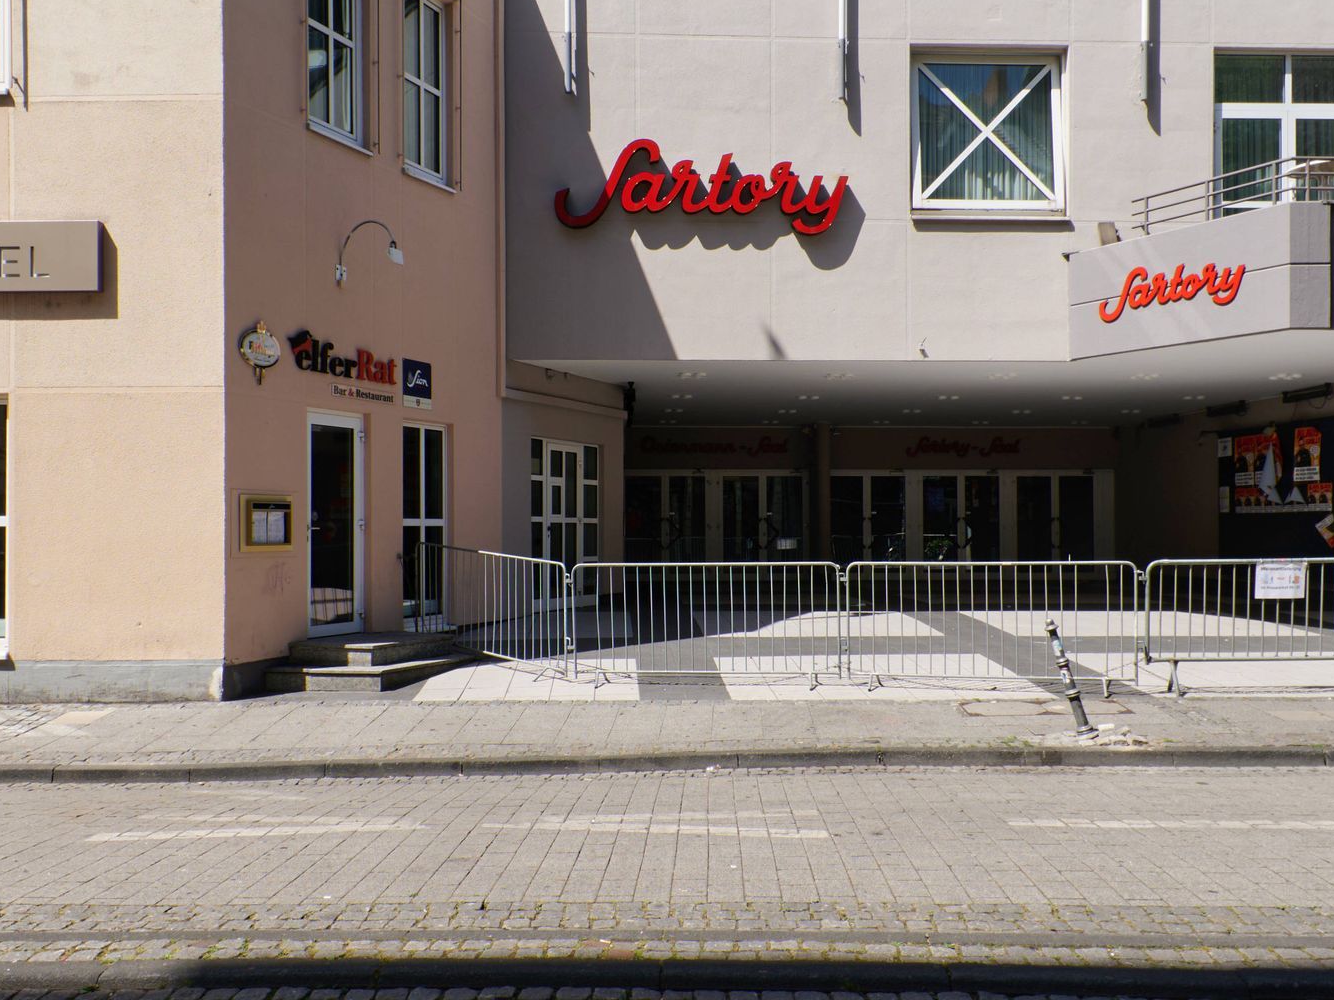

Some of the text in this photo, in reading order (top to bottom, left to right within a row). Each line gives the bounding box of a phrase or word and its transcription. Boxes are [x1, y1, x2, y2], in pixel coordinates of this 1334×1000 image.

[554, 138, 849, 236] Sartory
[1099, 262, 1246, 323] Sartory
[333, 385, 347, 396] Bar
[348, 387, 355, 397] &
[356, 388, 394, 403] Restaurant
[406, 369, 429, 388] Sion
